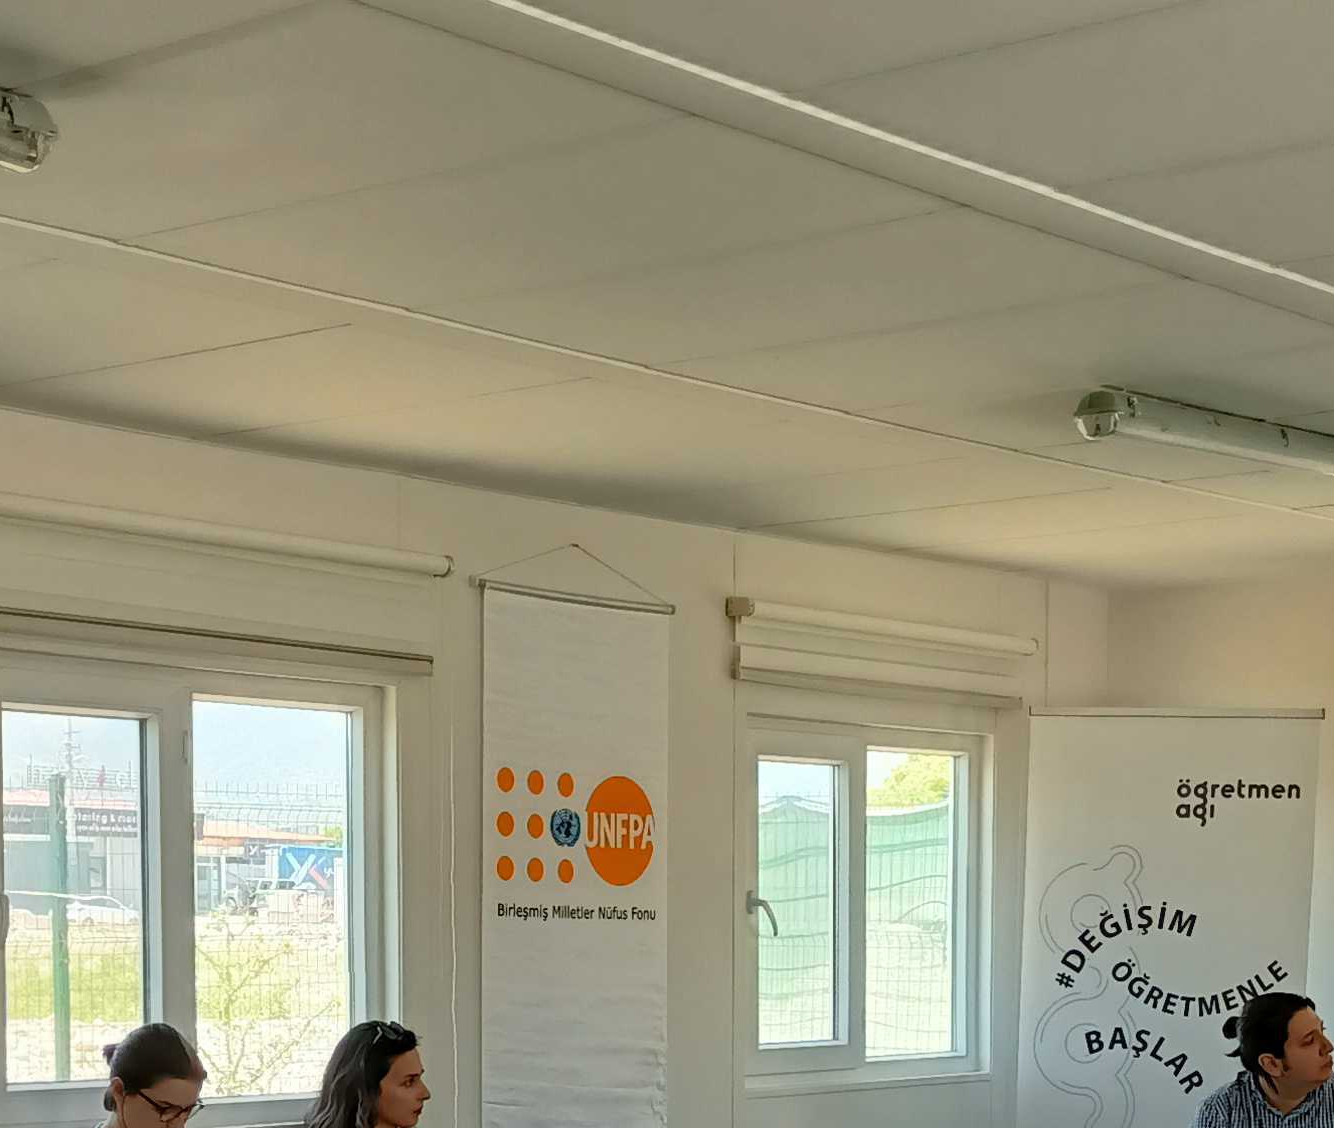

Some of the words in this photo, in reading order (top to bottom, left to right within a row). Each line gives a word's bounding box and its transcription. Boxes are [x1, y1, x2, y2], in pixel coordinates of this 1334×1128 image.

[585, 811, 658, 850] UNFPA
[497, 902, 549, 921] Birleşmiş
[552, 904, 595, 920] Milletler
[598, 906, 628, 921] Nüfus
[631, 906, 656, 921] Fonu
[1055, 901, 1198, 989] #DEĞİŞİM
[1111, 959, 1289, 1017] ÖĞRETMENLE
[1084, 1027, 1204, 1094] BAŞLAR
